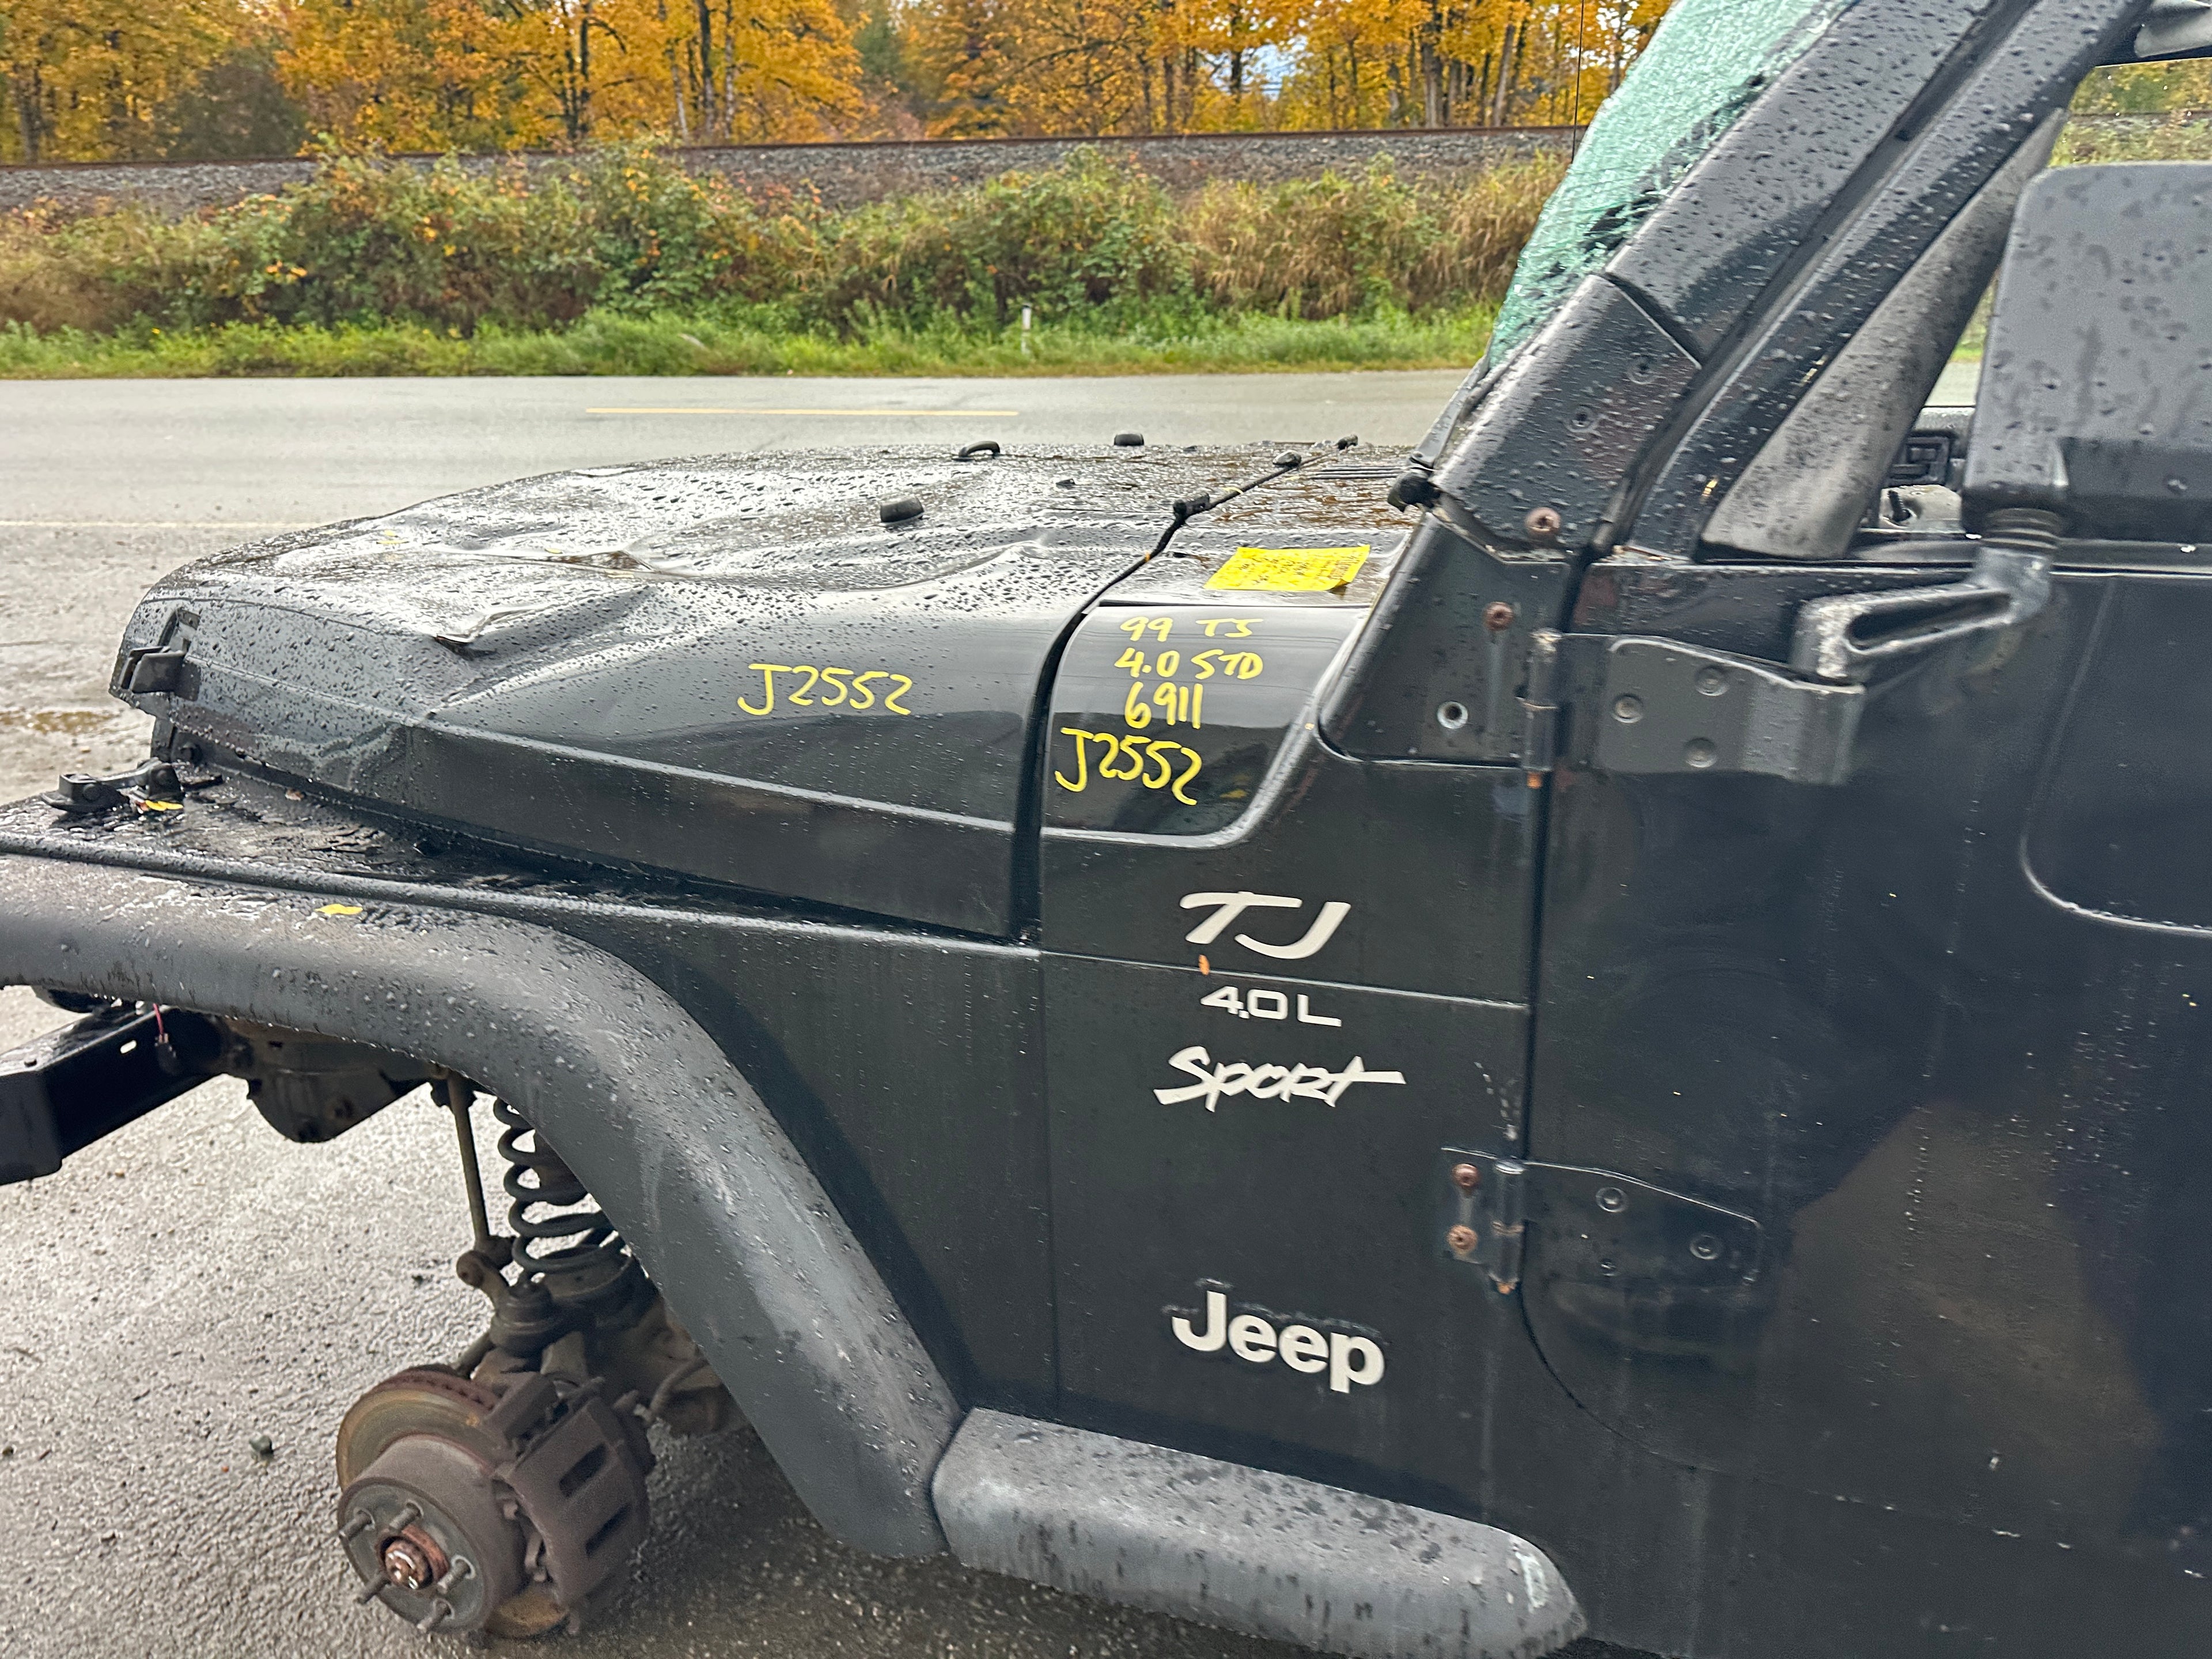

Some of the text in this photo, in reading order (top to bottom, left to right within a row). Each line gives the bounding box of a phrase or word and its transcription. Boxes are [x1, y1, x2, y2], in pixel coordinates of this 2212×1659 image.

[1120, 616, 1173, 642] 99
[737, 663, 912, 716] J2552
[1114, 647, 1263, 680] 4.0 STD
[1124, 681, 1203, 729] 6911
[1054, 726, 1203, 806] J2552
[1179, 891, 1351, 960] TJ
[1171, 1290, 1385, 1394] Jeep
